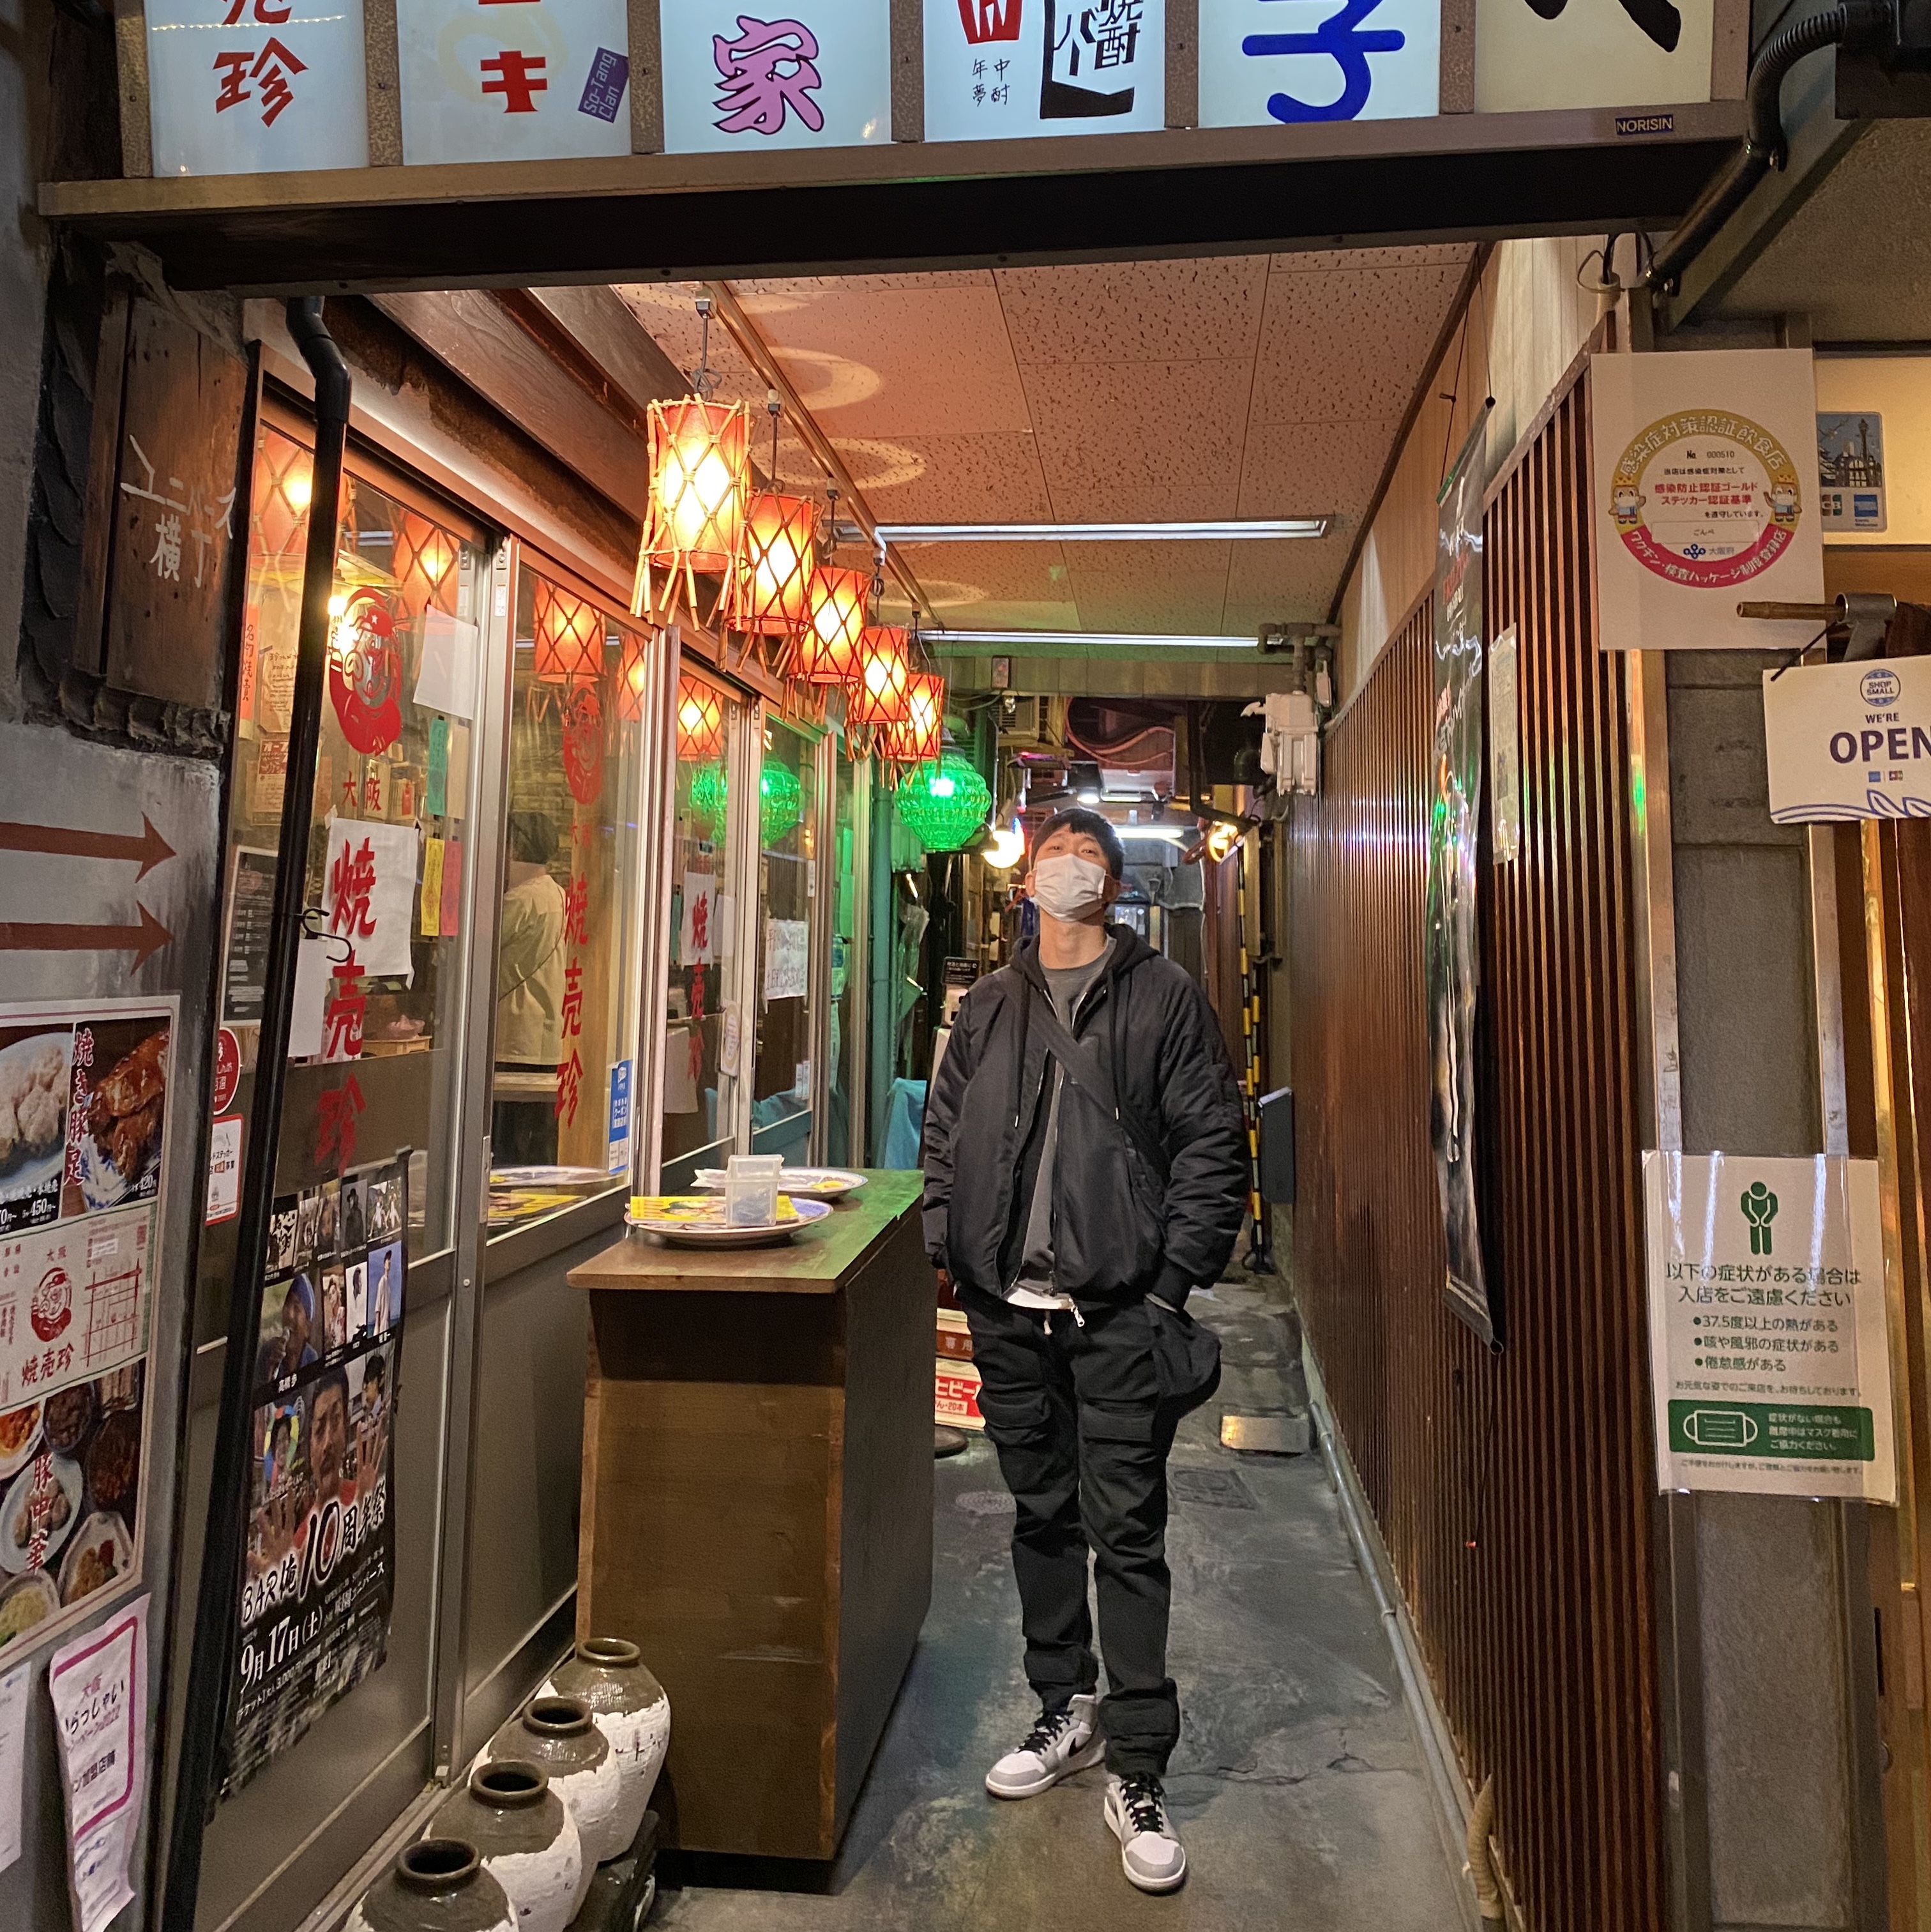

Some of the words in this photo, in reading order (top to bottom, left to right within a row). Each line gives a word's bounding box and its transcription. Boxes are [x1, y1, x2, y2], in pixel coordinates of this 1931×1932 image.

[583, 52, 617, 114] So-Tang
[712, 15, 824, 135] 家
[598, 86, 619, 119] Clan
[1616, 116, 1672, 132] NORISIN
[1619, 415, 1788, 476] 感染症対策認証飲食店
[1655, 482, 1759, 494] 感染防止認証ゴールド
[1661, 494, 1752, 505] ステッカー認証基準
[1865, 712, 1900, 724] WE'RE
[1829, 726, 1931, 764] OPEN
[342, 770, 381, 811] 大阪
[1667, 1262, 1861, 1285] 以下の症状がある場合は
[1678, 1285, 1851, 1307] 入店をご遠慮ください
[1702, 1314, 1839, 1333] 37.5度以上の熱がある
[1704, 1335, 1840, 1353] 咳や風邪の症状がある
[1705, 1357, 1787, 1373] 倦怠感がある
